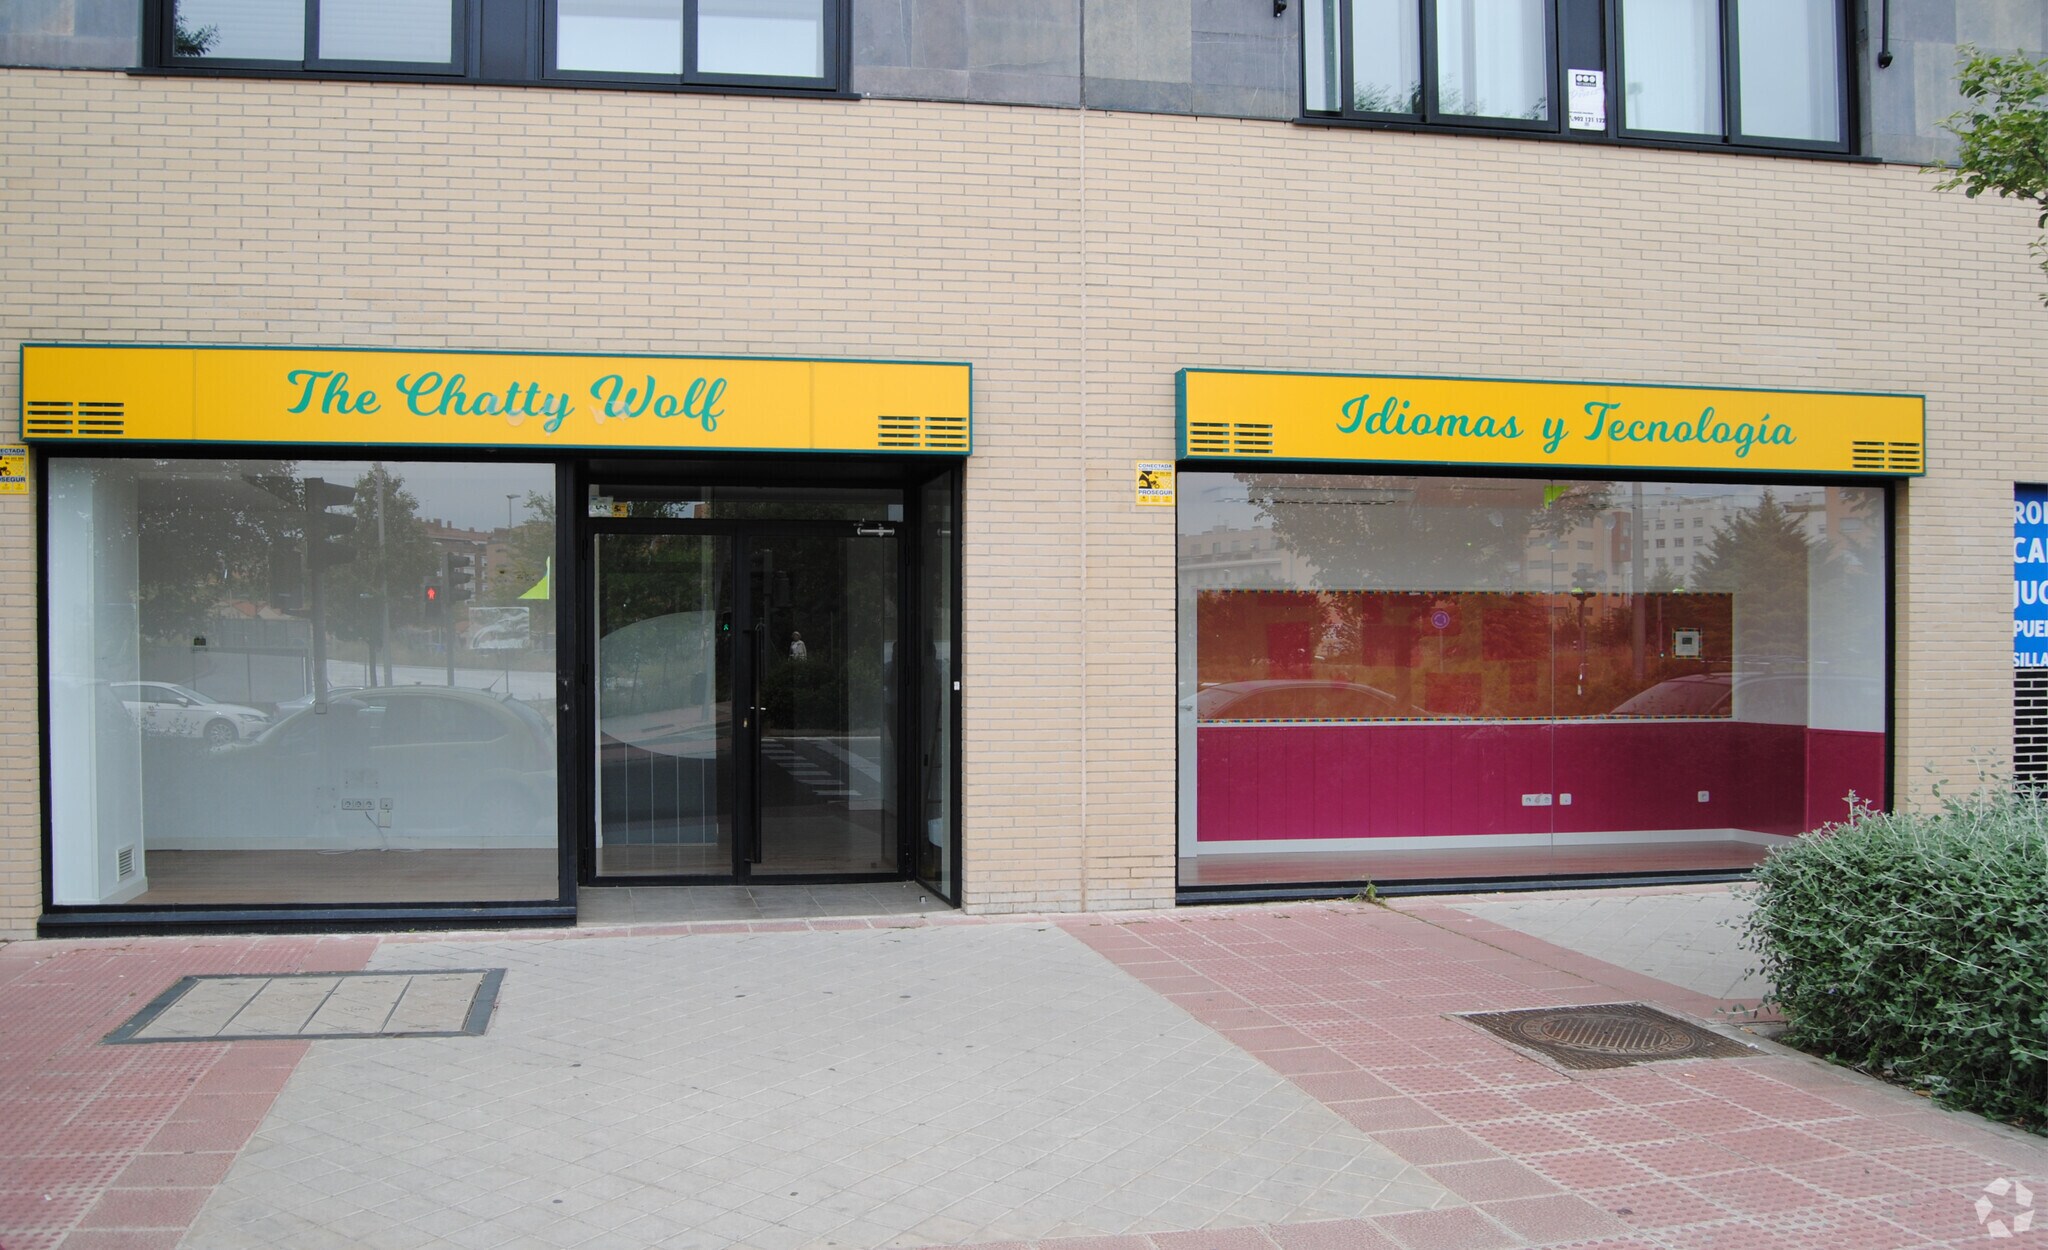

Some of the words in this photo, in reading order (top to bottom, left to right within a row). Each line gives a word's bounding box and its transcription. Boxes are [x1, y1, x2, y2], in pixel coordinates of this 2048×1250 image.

[286, 368, 382, 415] The
[395, 370, 576, 434] Chatty
[589, 373, 728, 433] Wolf
[1335, 393, 1525, 439] Idiomas
[1541, 417, 1569, 455] y
[1583, 400, 1798, 459] Tecnología
[2014, 536, 2048, 564] CA
